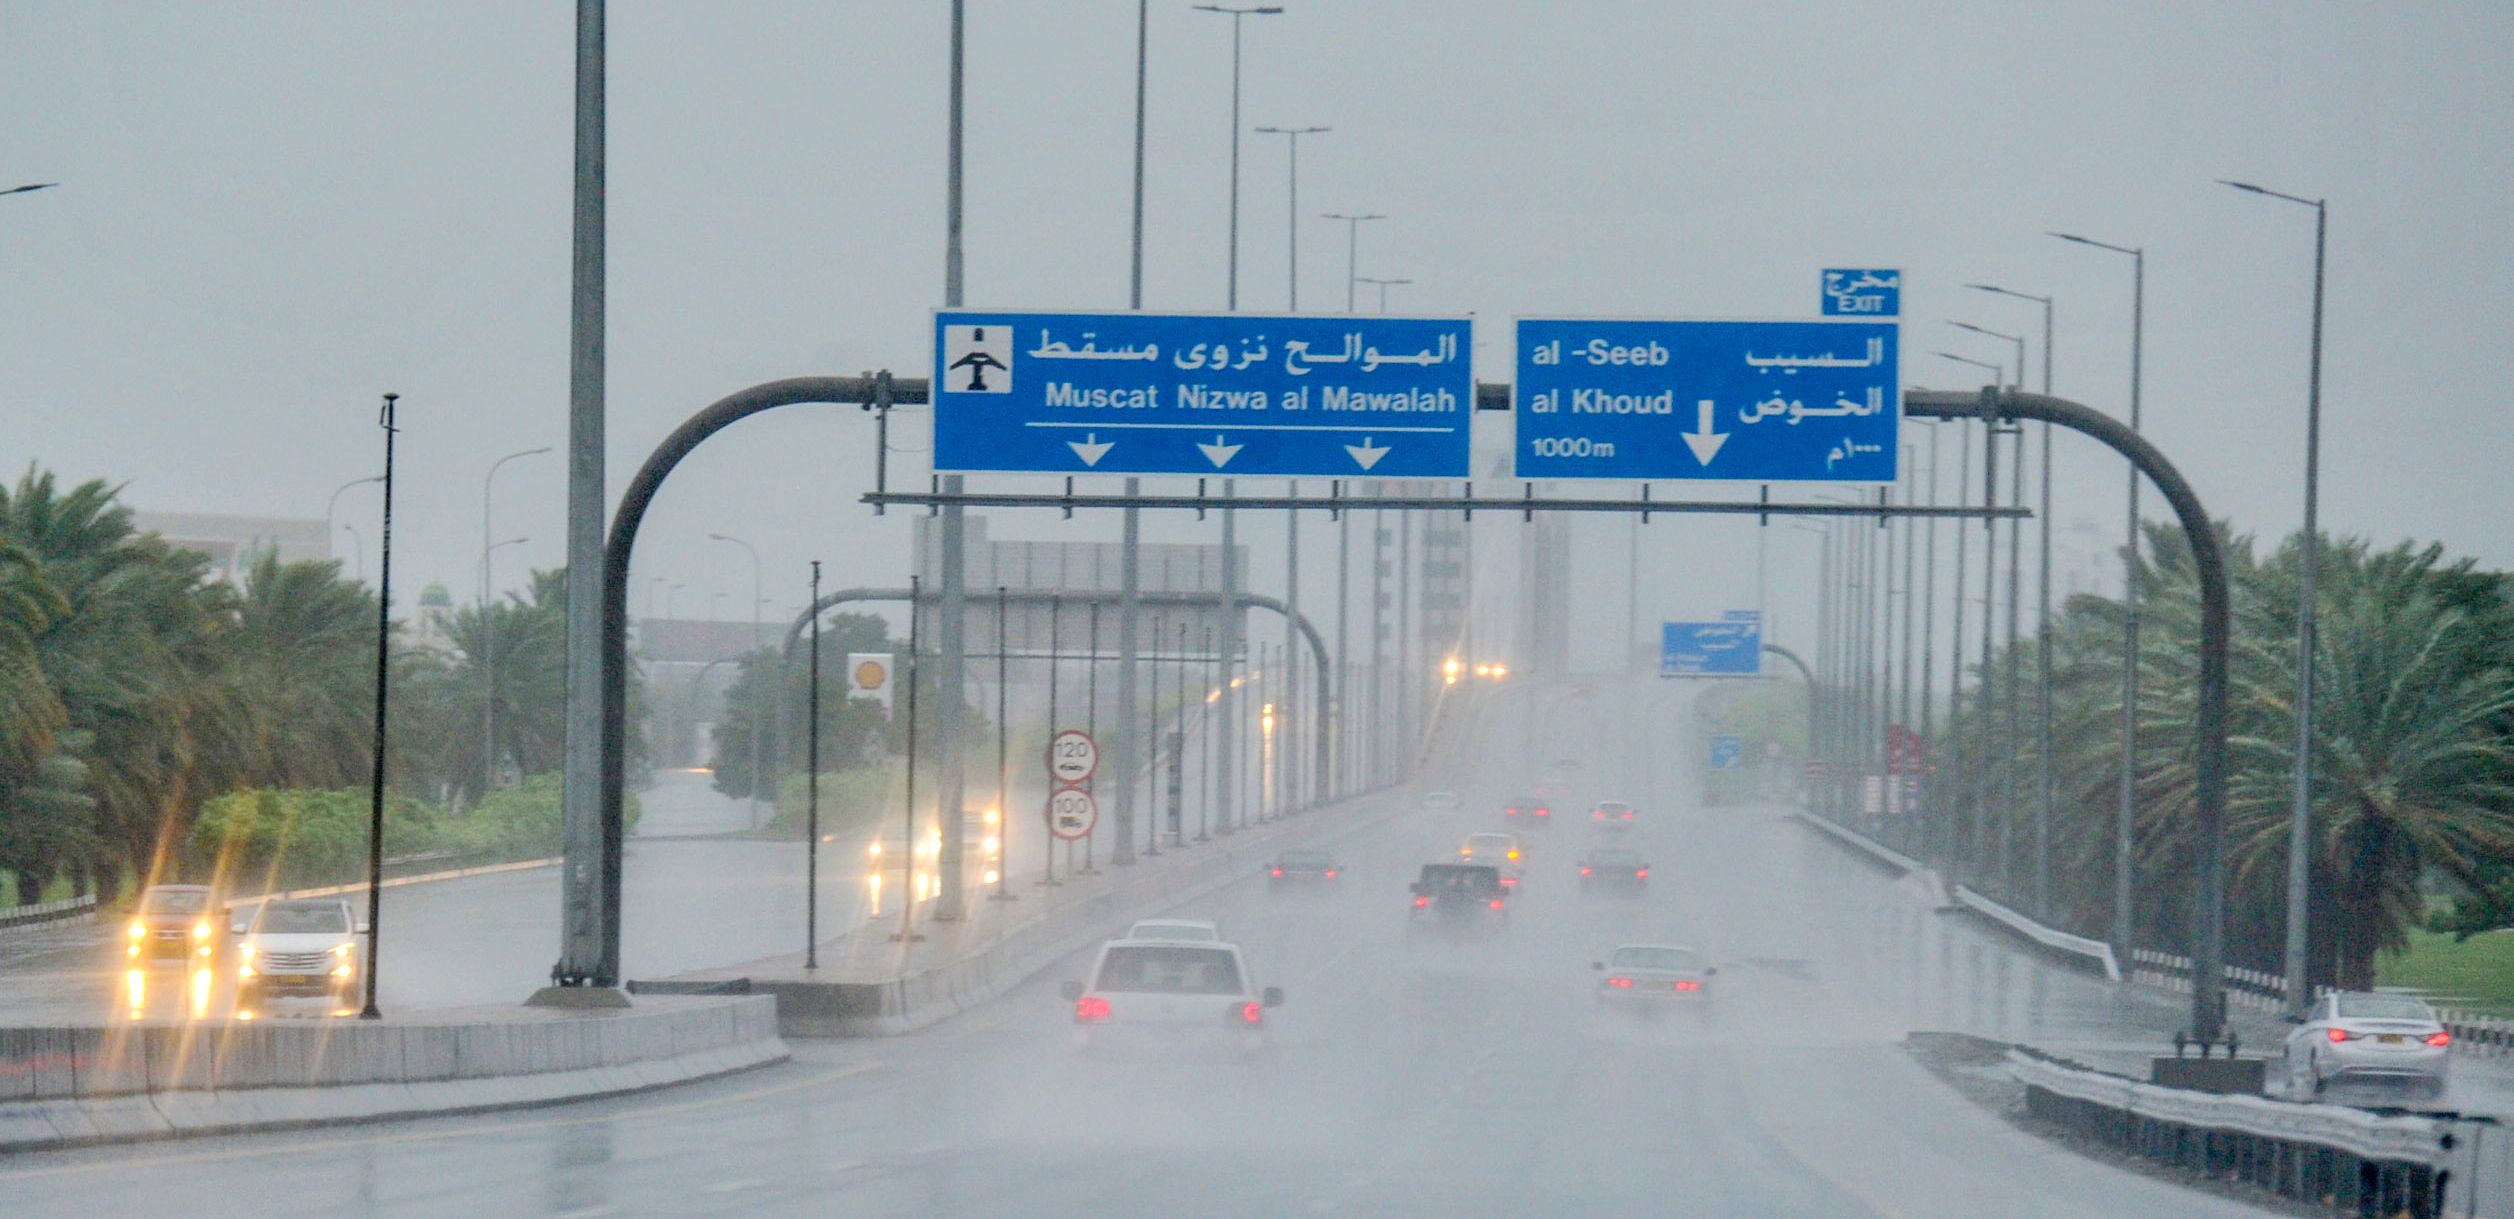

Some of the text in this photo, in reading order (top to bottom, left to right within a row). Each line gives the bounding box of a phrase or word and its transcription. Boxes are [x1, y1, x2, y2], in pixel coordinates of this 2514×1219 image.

[1825, 270, 1898, 297] مخرج
[1838, 295, 1884, 313] EXIT
[1027, 328, 1457, 376] الموالح نزوى مسقط
[1532, 340, 1560, 365] al
[1745, 336, 1883, 375] السيب
[1045, 381, 1456, 412] Muscat Nizwa al Mawalah
[1531, 387, 1673, 414] al Khoud
[1739, 385, 1883, 425] الخوض
[1531, 437, 1615, 458] 1000m
[1055, 742, 1087, 758] 120
[1055, 798, 1087, 814] 100
